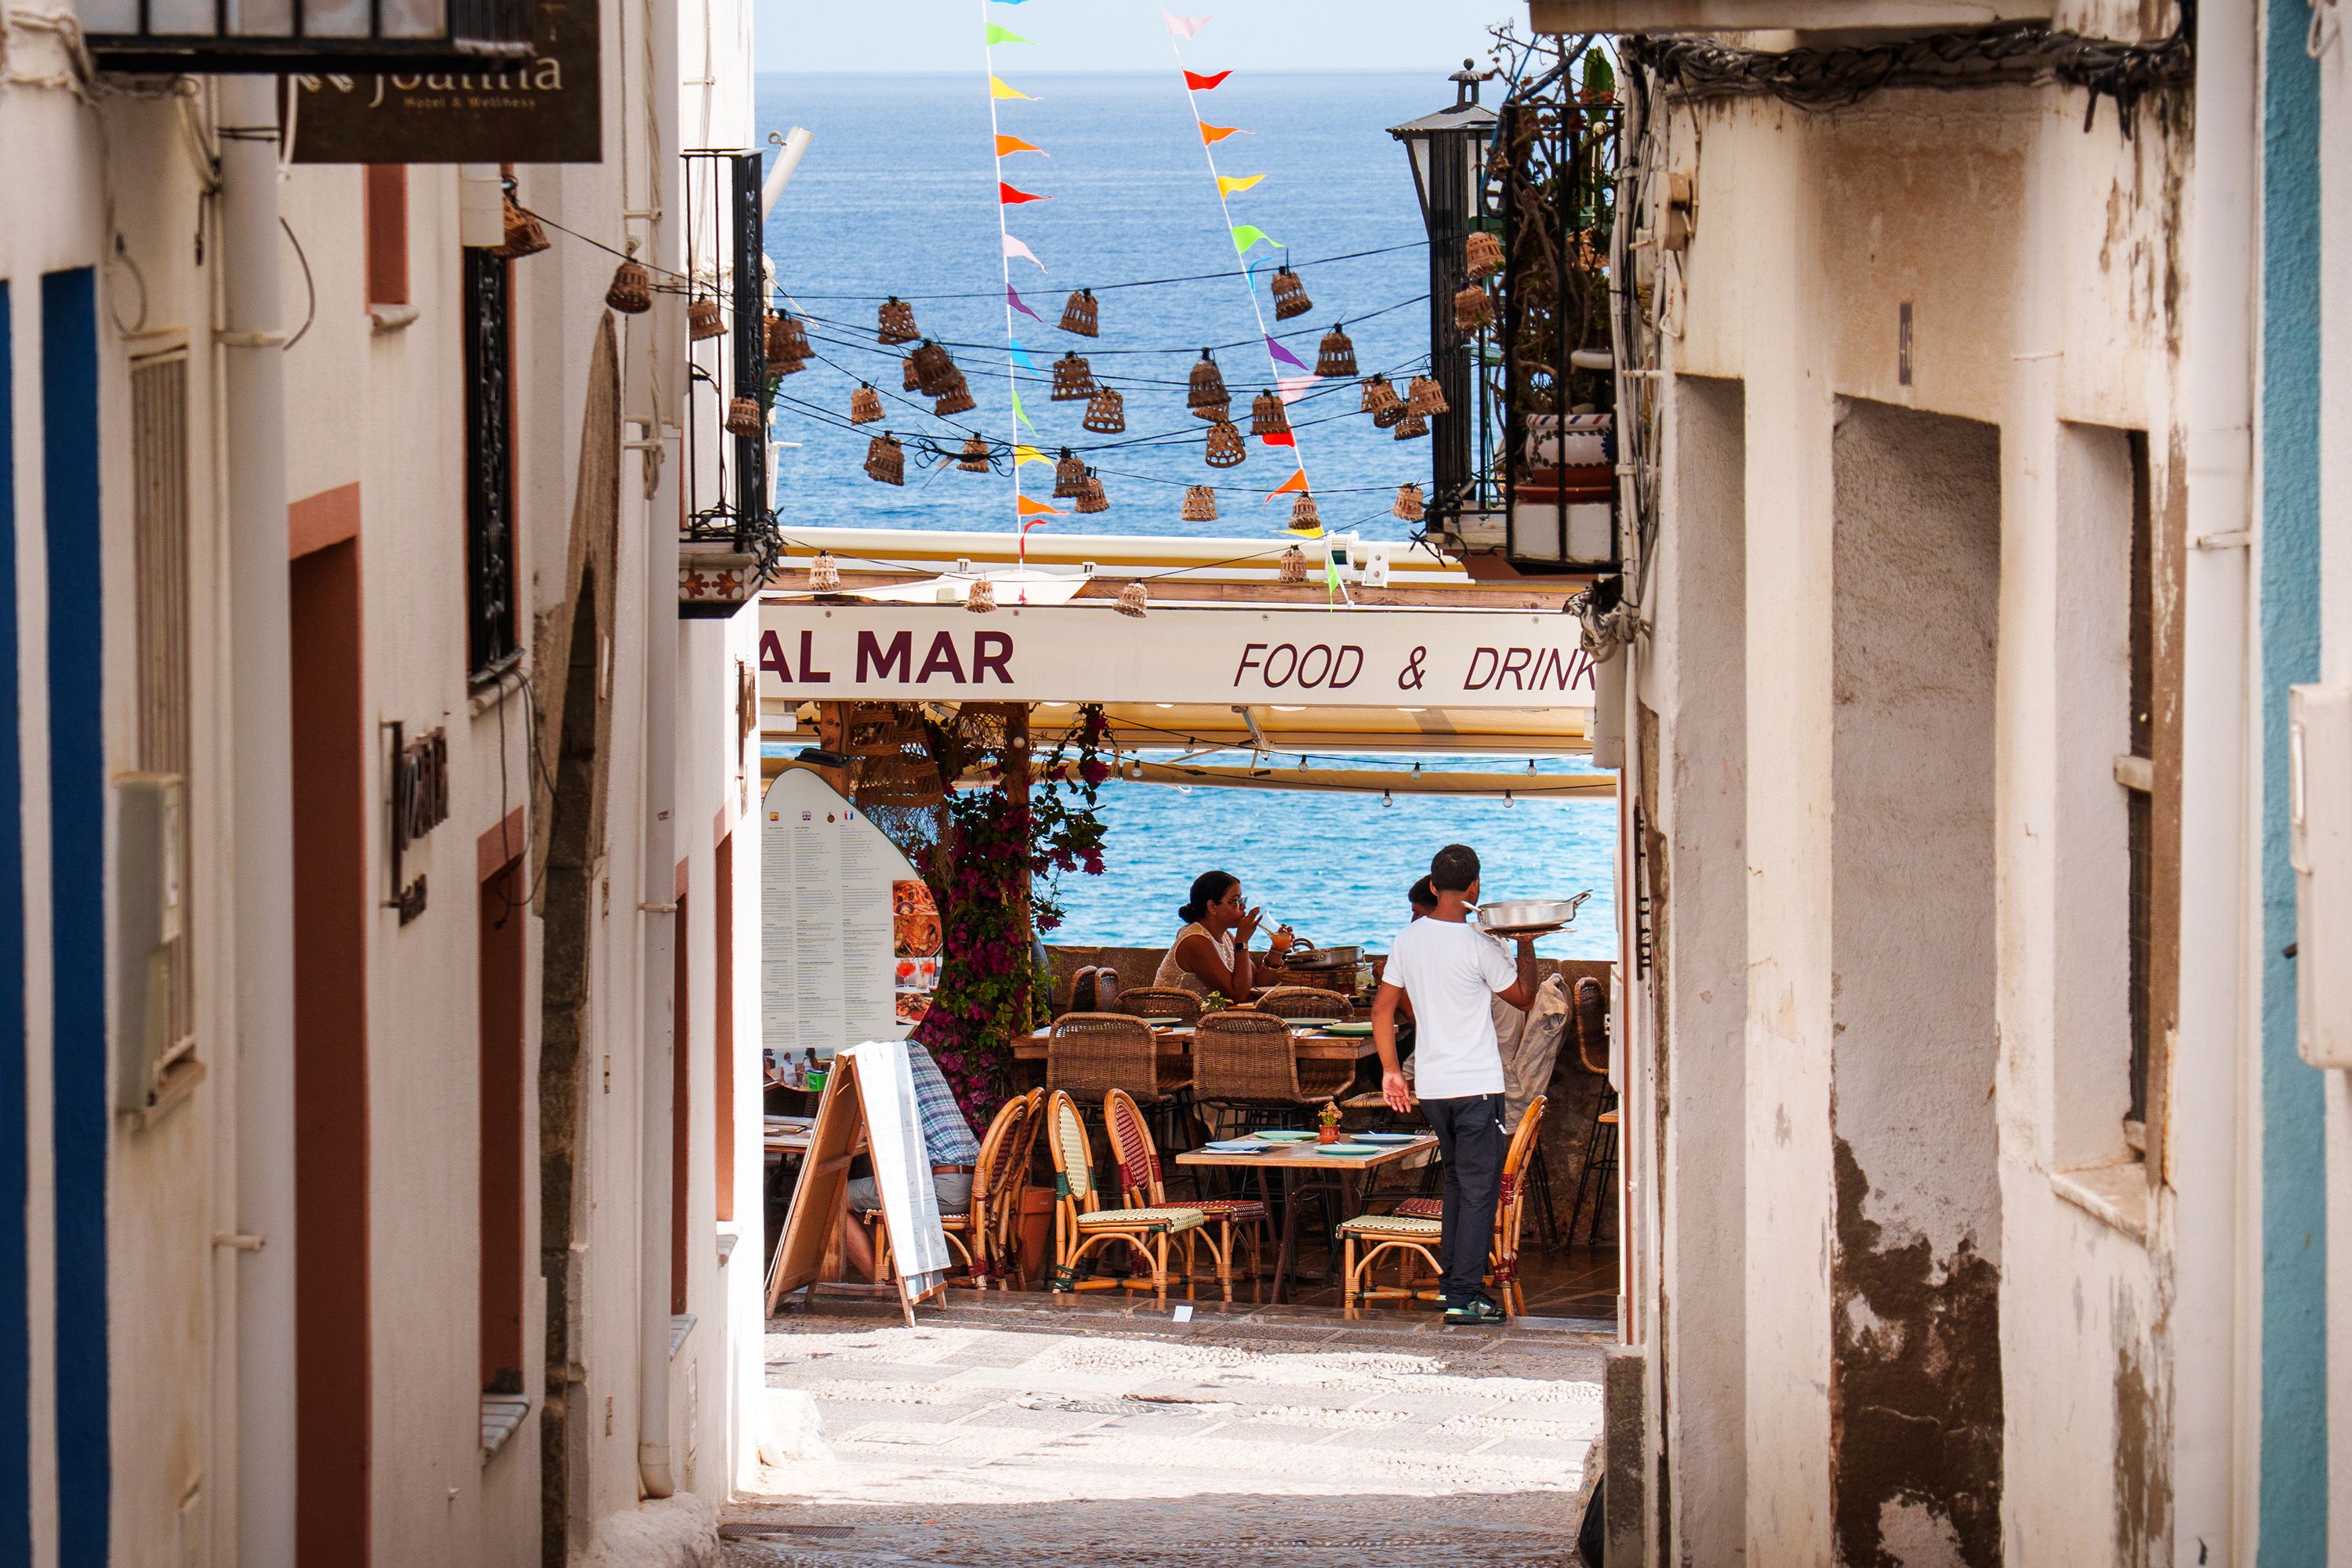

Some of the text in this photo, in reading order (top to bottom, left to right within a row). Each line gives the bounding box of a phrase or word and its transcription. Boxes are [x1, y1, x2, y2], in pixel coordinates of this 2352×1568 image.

[404, 96, 536, 109] Hotel & Wellness
[759, 630, 1014, 684] AL MAR
[1234, 643, 1596, 691] FOOD & DRINK
